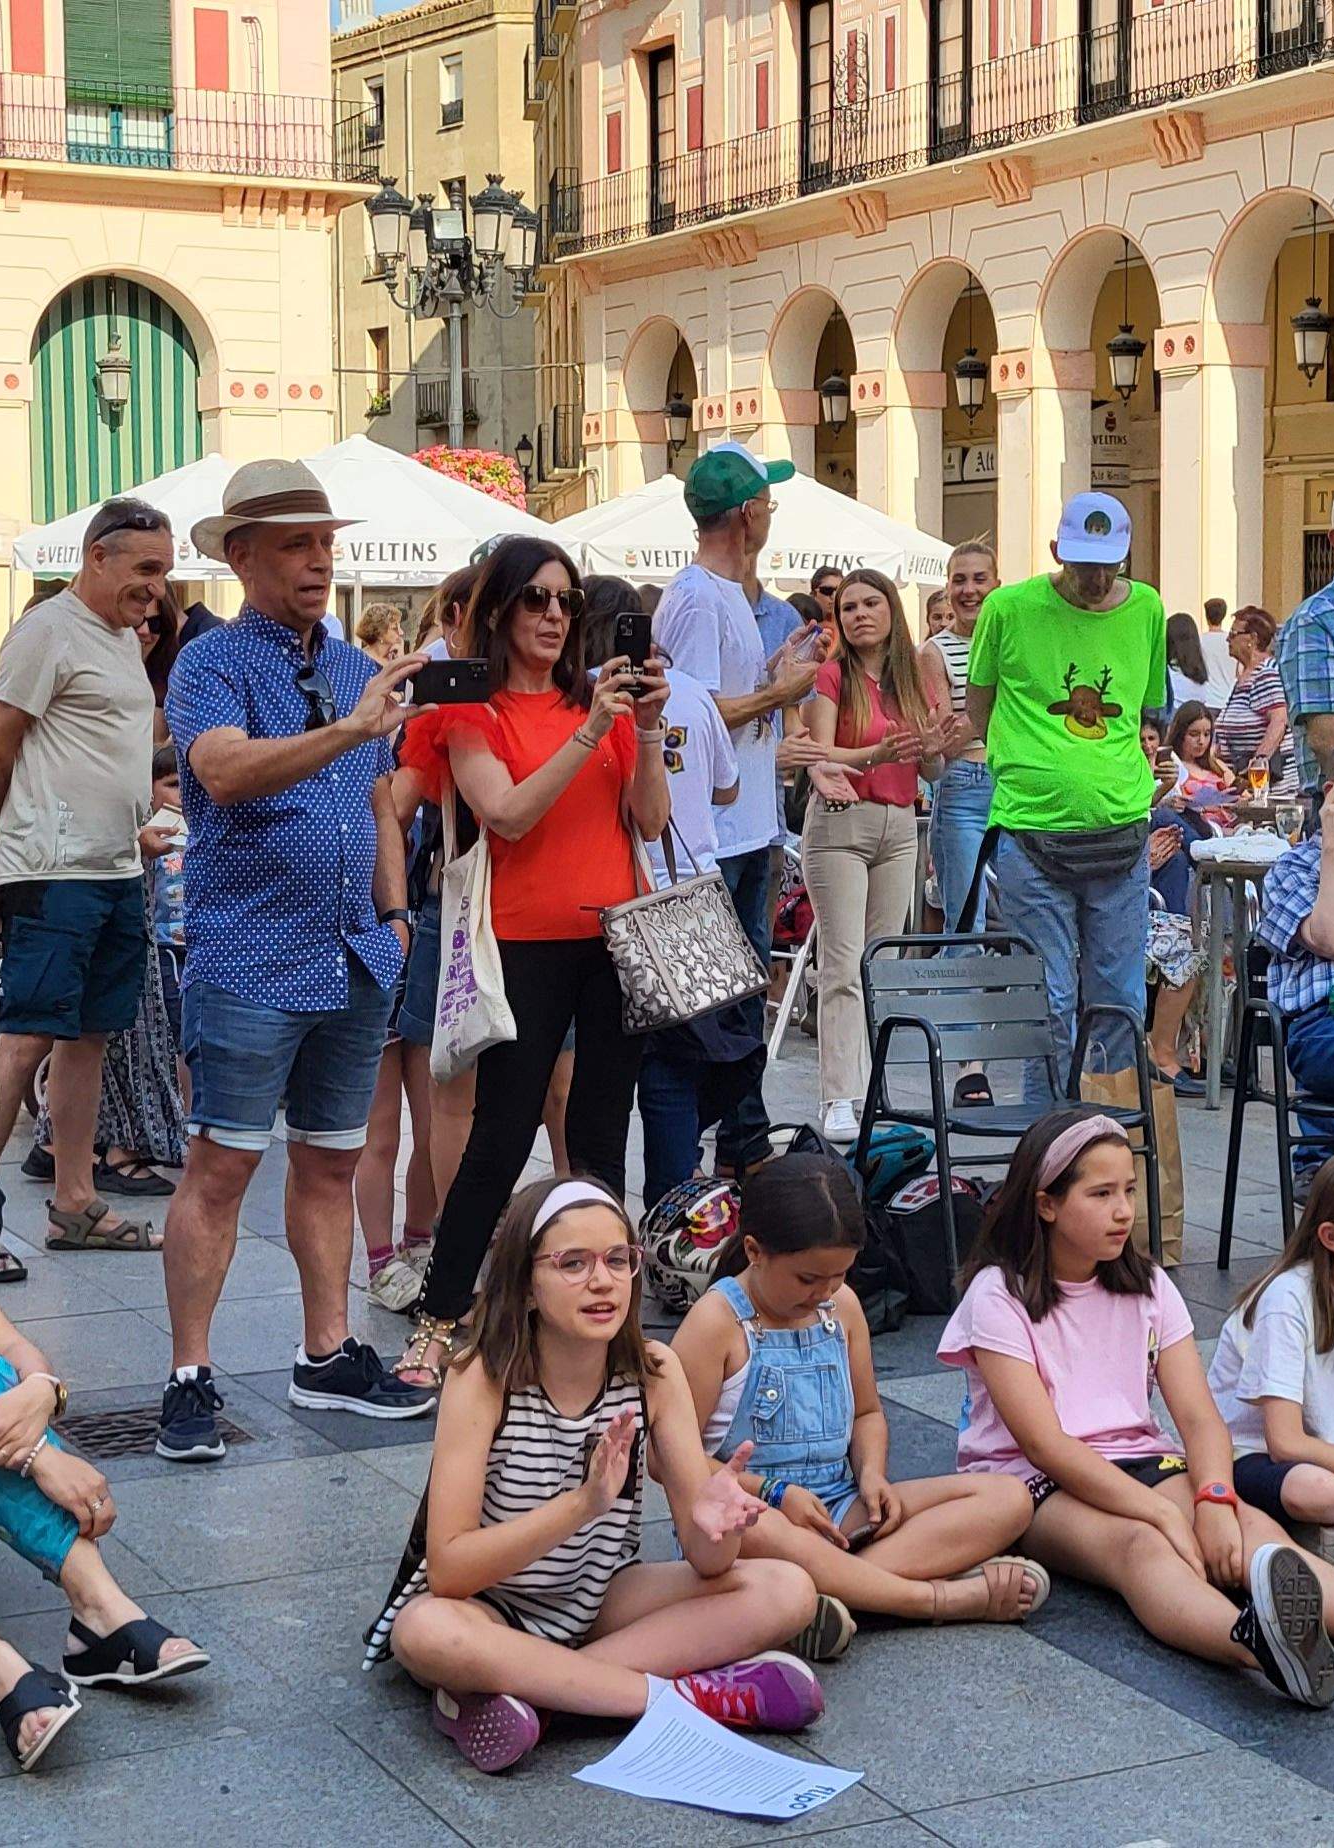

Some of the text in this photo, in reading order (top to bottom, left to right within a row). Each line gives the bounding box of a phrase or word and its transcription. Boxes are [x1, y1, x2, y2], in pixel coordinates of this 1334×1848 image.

[1091, 434, 1128, 446] VELTINS
[48, 545, 83, 563] VELTI
[350, 542, 438, 562] VELTINS
